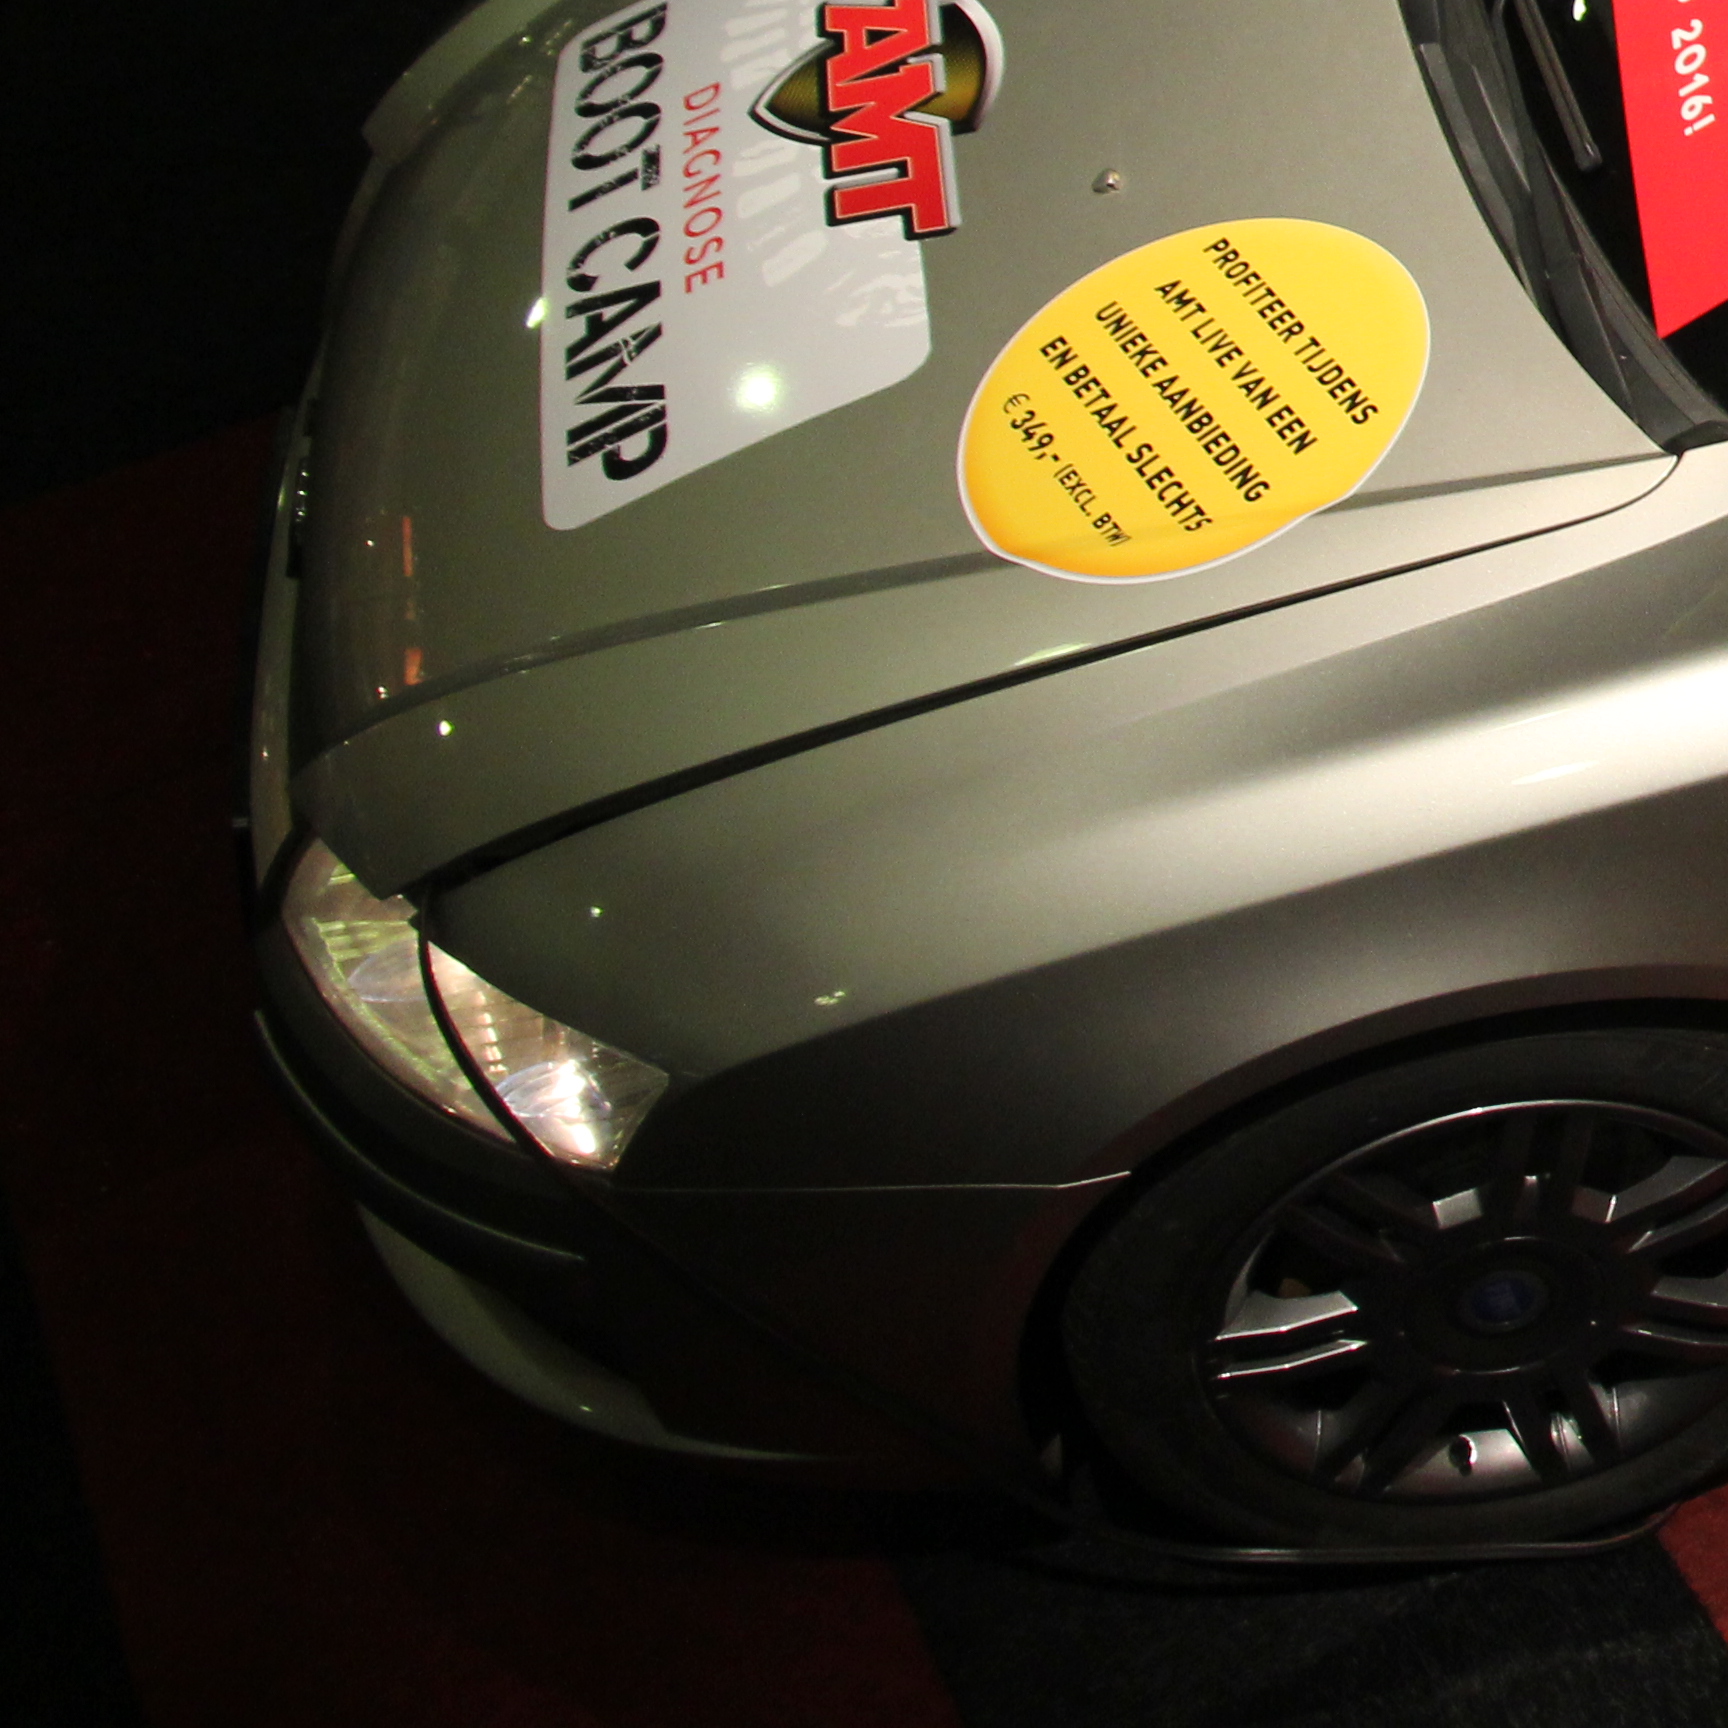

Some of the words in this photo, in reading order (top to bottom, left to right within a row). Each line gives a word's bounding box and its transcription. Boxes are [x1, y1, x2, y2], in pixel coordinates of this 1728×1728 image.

[568, 1, 668, 212] BOOT
[1670, 18, 1716, 137] 2016!
[683, 81, 725, 294] DIAGNOSE
[565, 216, 669, 481] CAMP
[1095, 300, 1168, 378] UNIEKE
[1152, 375, 1271, 503] AANBIEDING
[1154, 279, 1207, 322] AMT
[1190, 317, 1243, 368] LIVE
[1231, 360, 1280, 412] VAN
[1265, 405, 1318, 456] EEN
[1203, 237, 1305, 344] PROFITEER
[1294, 336, 1379, 425] TIJDENS
[1039, 335, 1079, 371] EN
[1063, 364, 1137, 449] BETAAL
[1125, 442, 1213, 532] SLECHTS
[1052, 462, 1097, 518] (EXCL.
